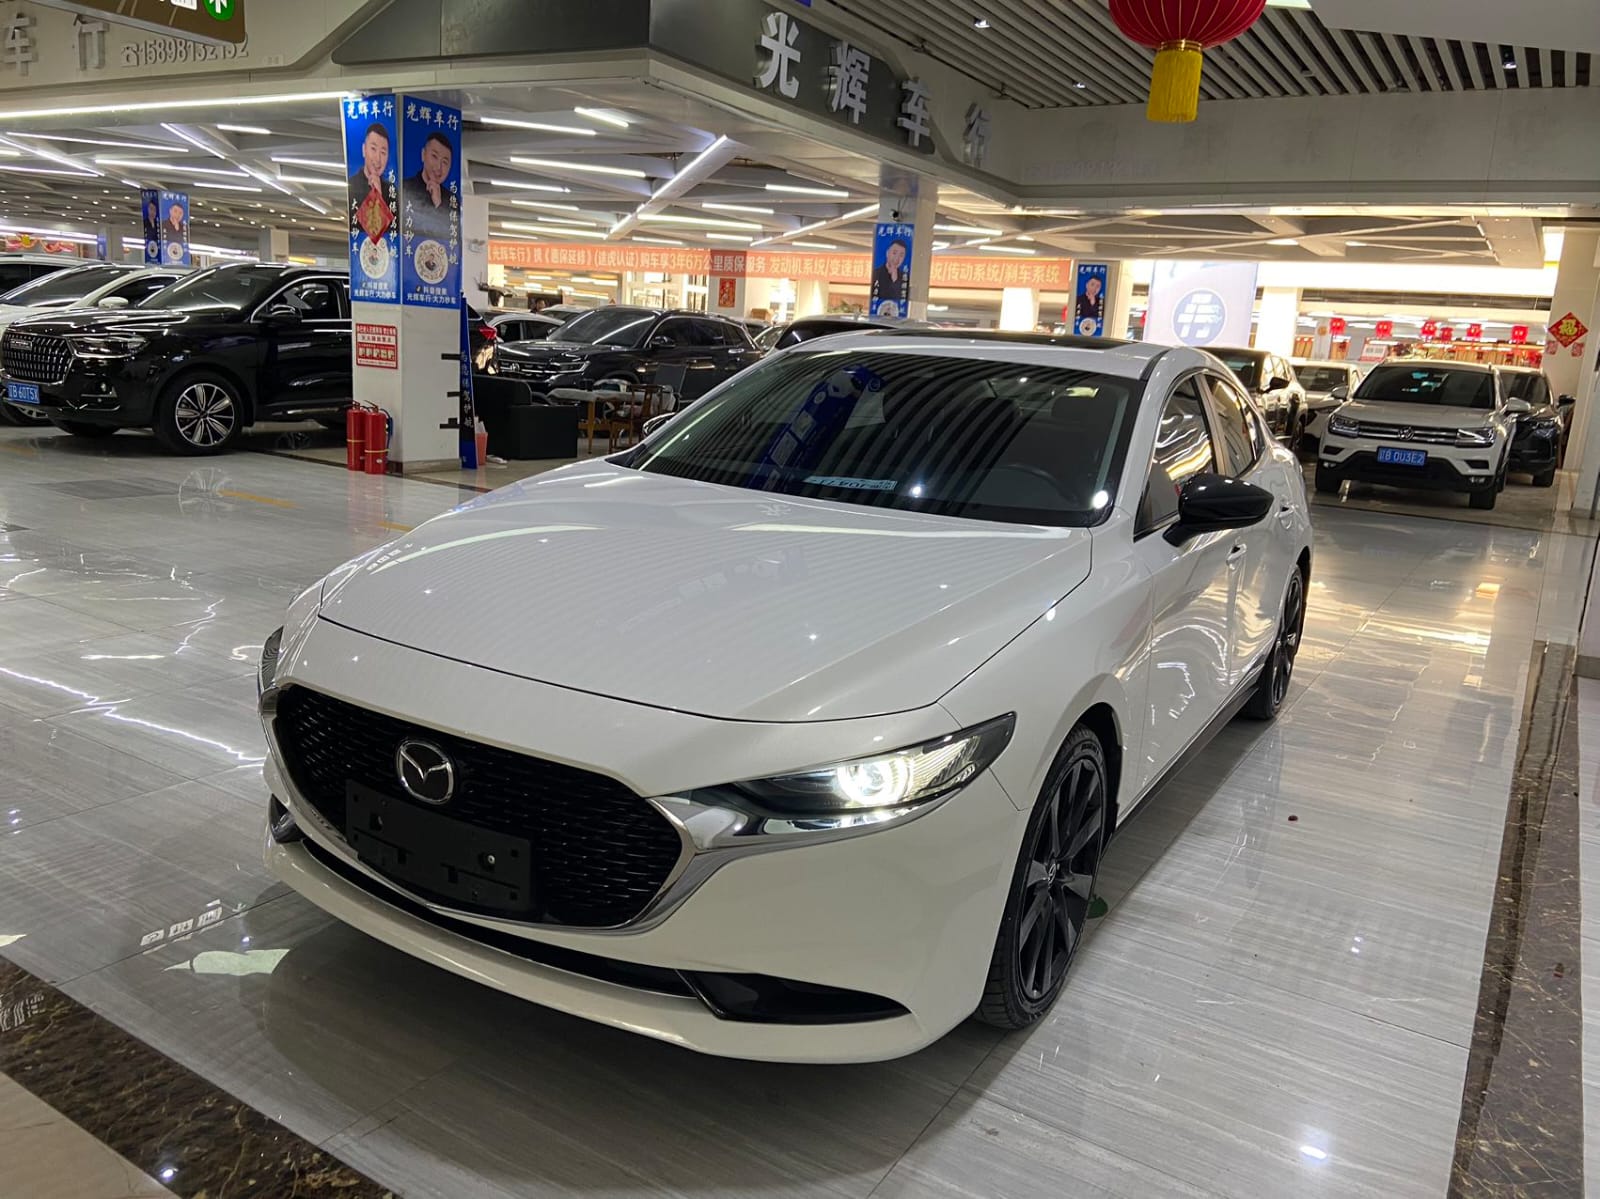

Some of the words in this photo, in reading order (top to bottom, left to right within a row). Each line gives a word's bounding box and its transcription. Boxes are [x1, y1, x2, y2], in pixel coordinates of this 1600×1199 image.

[753, 11, 993, 168] 光辉车行
[346, 100, 393, 119] 光辉车行
[406, 102, 459, 131] 光辉车行
